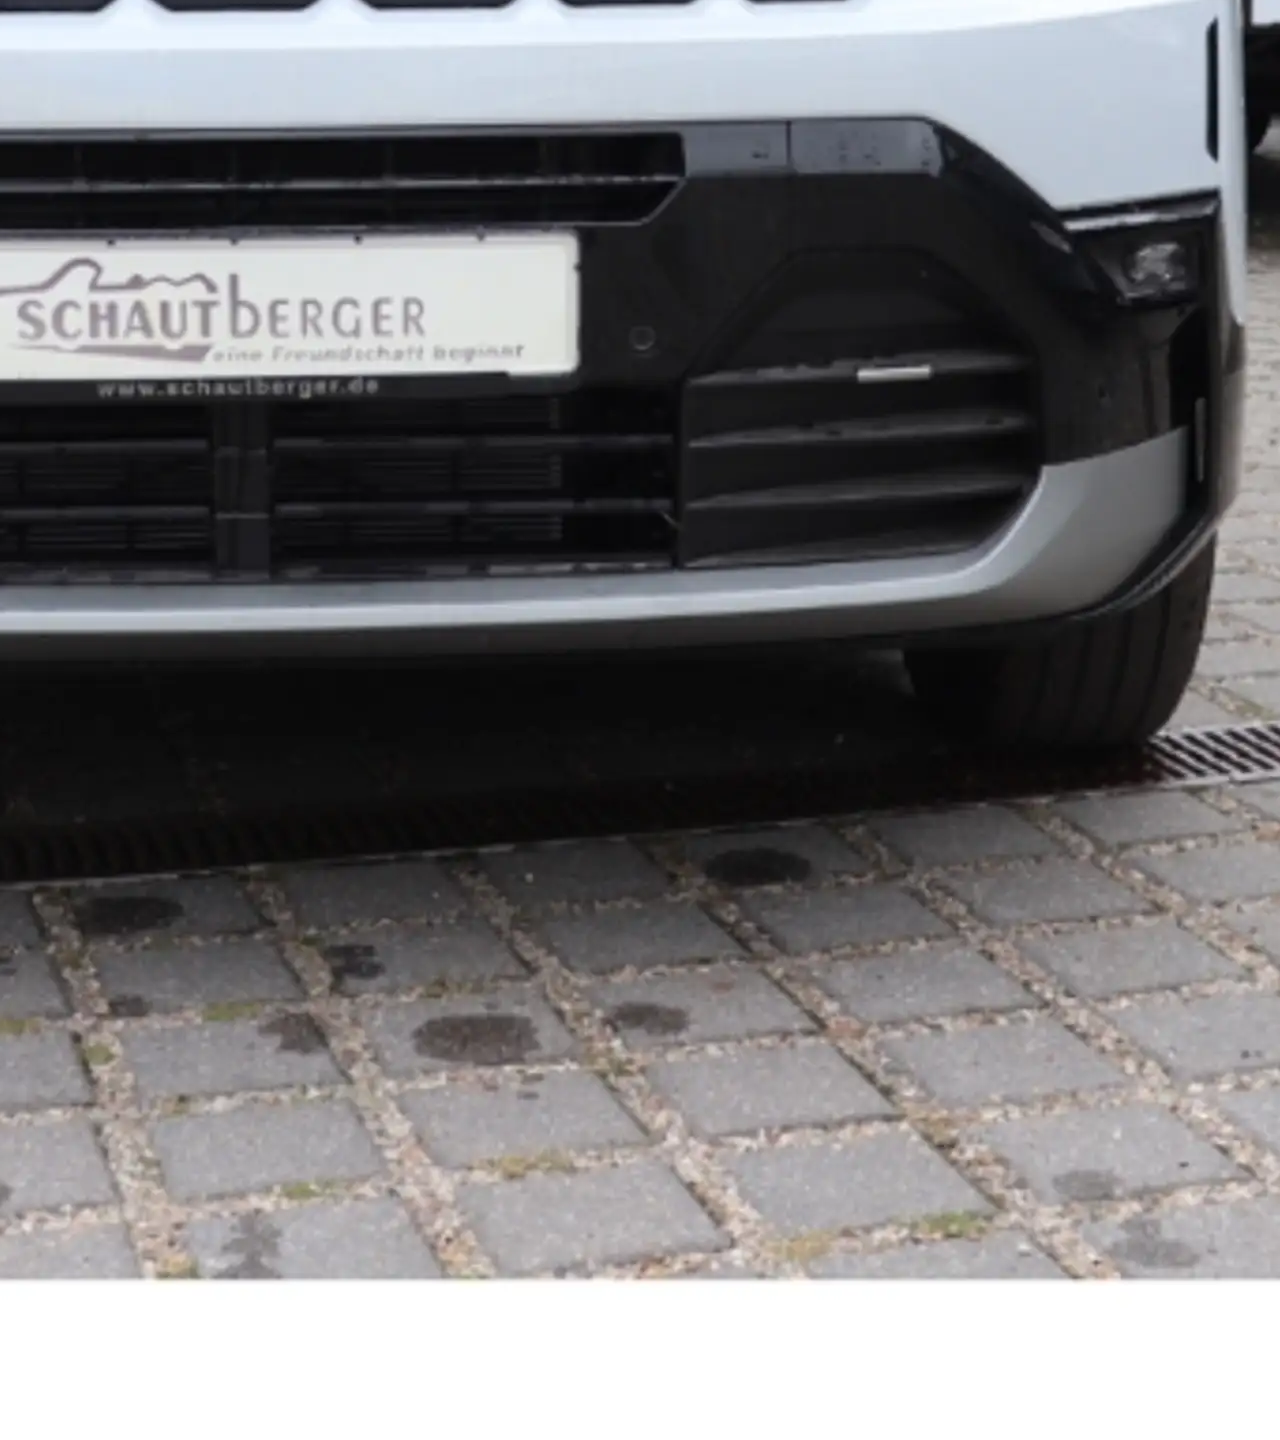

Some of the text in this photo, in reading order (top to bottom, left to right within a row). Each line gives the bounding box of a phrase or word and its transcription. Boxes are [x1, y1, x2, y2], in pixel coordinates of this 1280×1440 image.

[212, 341, 526, 364] eine Freundschaft beginnt
